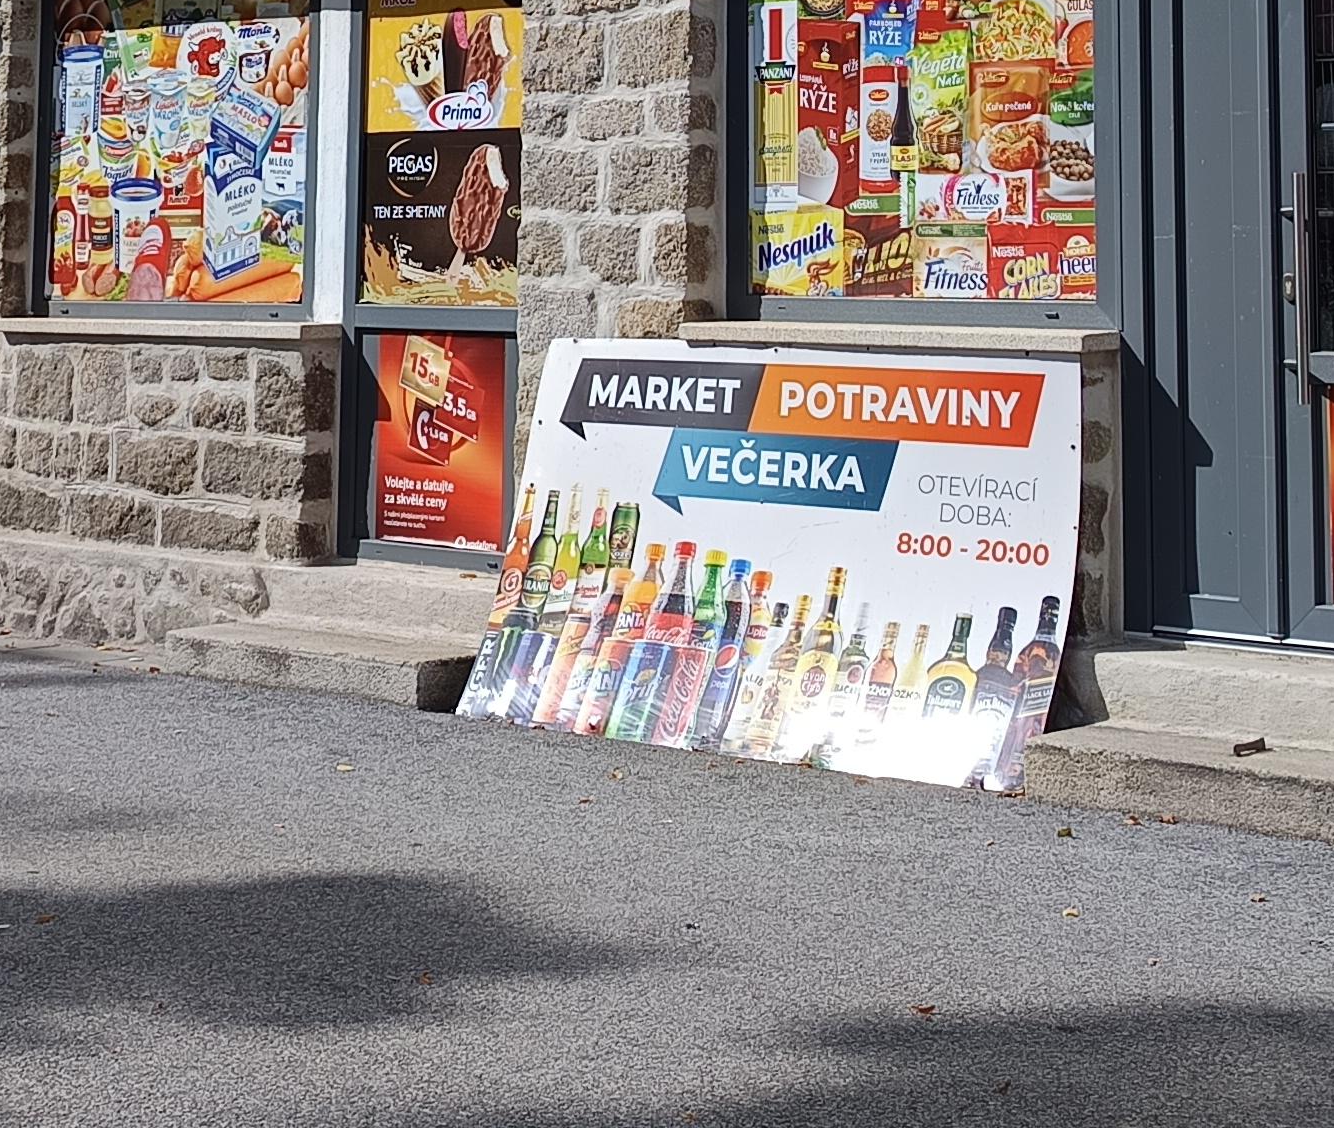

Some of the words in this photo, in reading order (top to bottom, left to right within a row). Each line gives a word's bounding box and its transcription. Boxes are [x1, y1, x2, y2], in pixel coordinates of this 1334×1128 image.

[237, 25, 272, 40] Monte
[869, 26, 902, 46] RÝŽE
[759, 66, 793, 79] PANZANI
[799, 85, 837, 113] RÝŽE
[231, 103, 258, 124] MÁSLO
[442, 103, 482, 120] Prima
[268, 156, 294, 168] MLÉKO
[388, 155, 433, 174] PEGAS
[224, 183, 256, 203] MLÉKO
[956, 188, 1000, 206] Fitness
[373, 206, 391, 219] TEN
[392, 205, 404, 218] ZE
[405, 204, 447, 219] SMETANY
[758, 222, 835, 272] Nesquik
[923, 259, 988, 291] Fitness
[1004, 251, 1050, 285] CORN
[587, 374, 742, 414] MARKET
[779, 381, 1022, 429] POTRAVINY
[681, 438, 865, 493] VEČERKA
[384, 475, 414, 491] Volejte
[415, 480, 422, 490] a
[423, 478, 455, 494] datujte
[918, 474, 1039, 502] OTEVÍRACÍ
[384, 493, 395, 504] za
[396, 492, 424, 507] skvělé
[425, 498, 447, 511] ceny
[939, 502, 1012, 527] DOBA:
[896, 532, 952, 557] 8:00
[975, 538, 1050, 566] 20:00
[746, 624, 768, 639] Lipto
